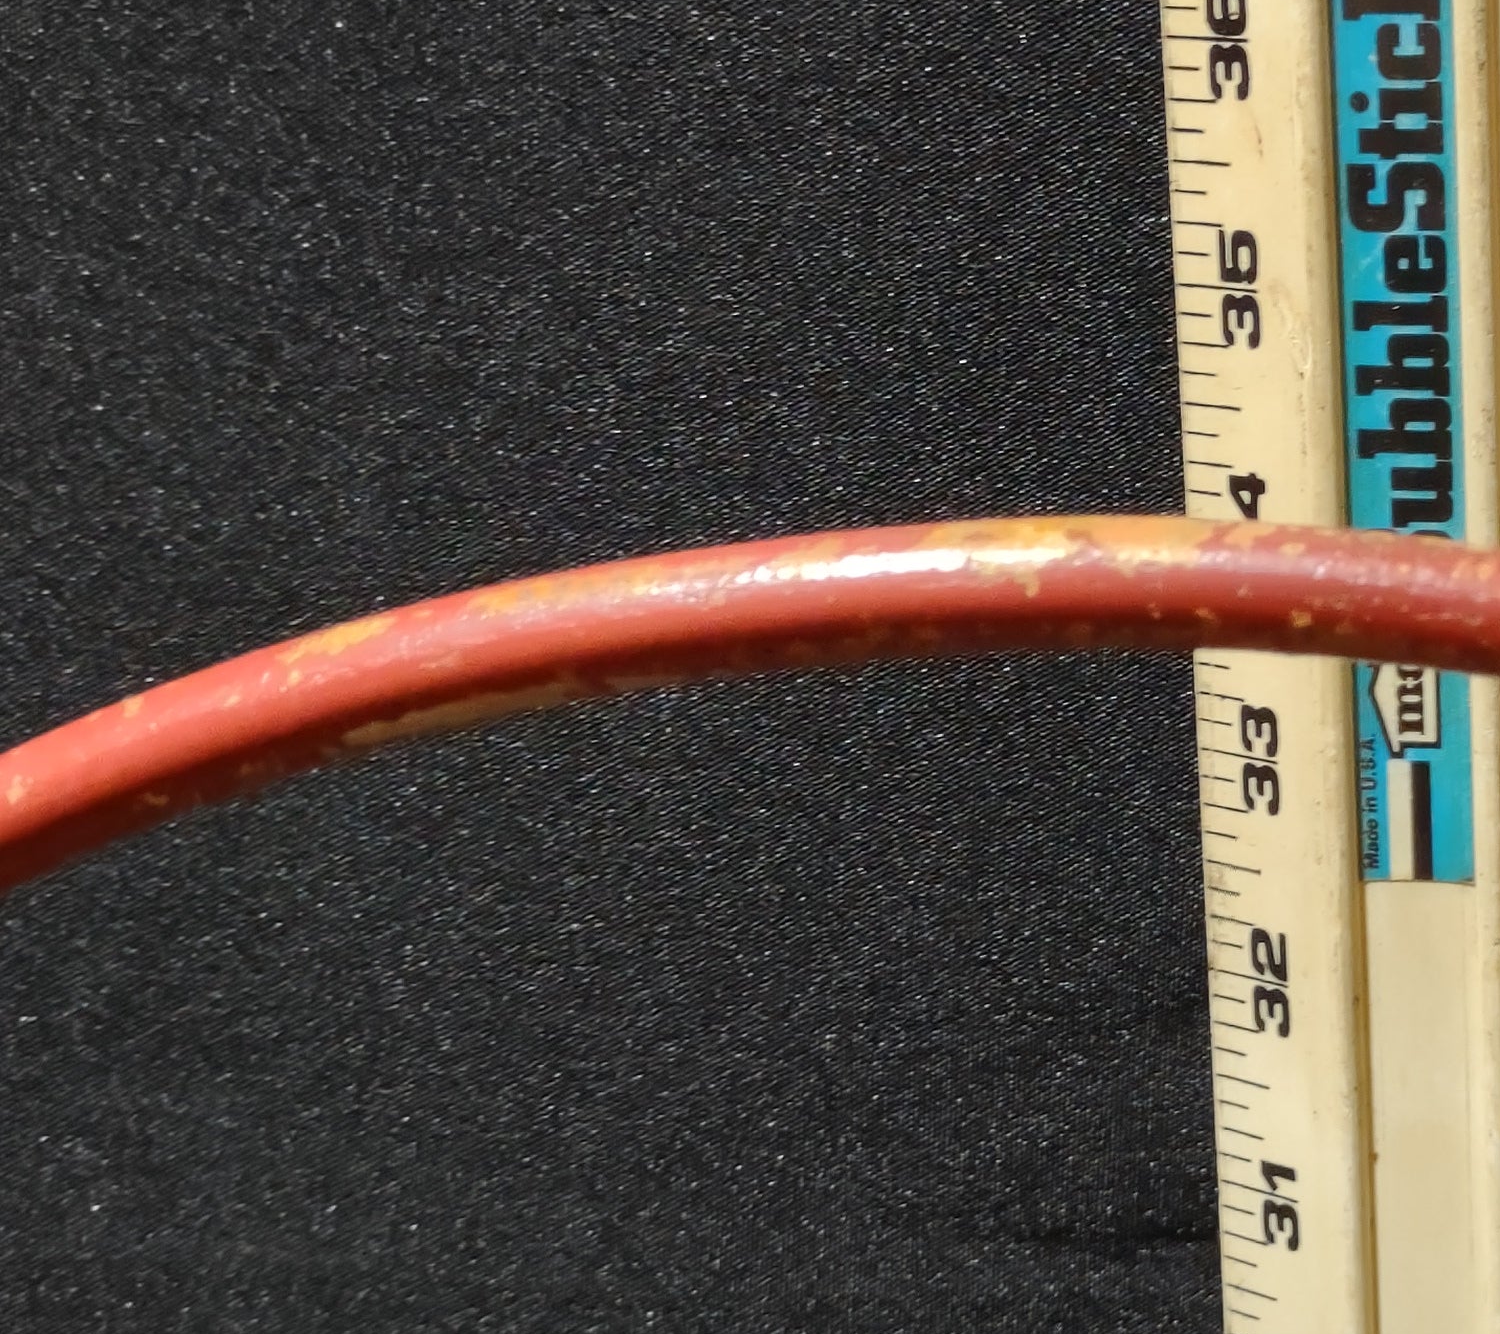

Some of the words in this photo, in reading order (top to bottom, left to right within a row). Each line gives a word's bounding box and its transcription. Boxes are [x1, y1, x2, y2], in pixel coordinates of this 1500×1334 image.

[1218, 230, 1260, 349] 35
[1240, 705, 1281, 816] 33
[1364, 796, 1379, 812] in
[1361, 818, 1380, 869] Made
[1250, 928, 1291, 1038] 32
[1260, 1160, 1300, 1251] 31
